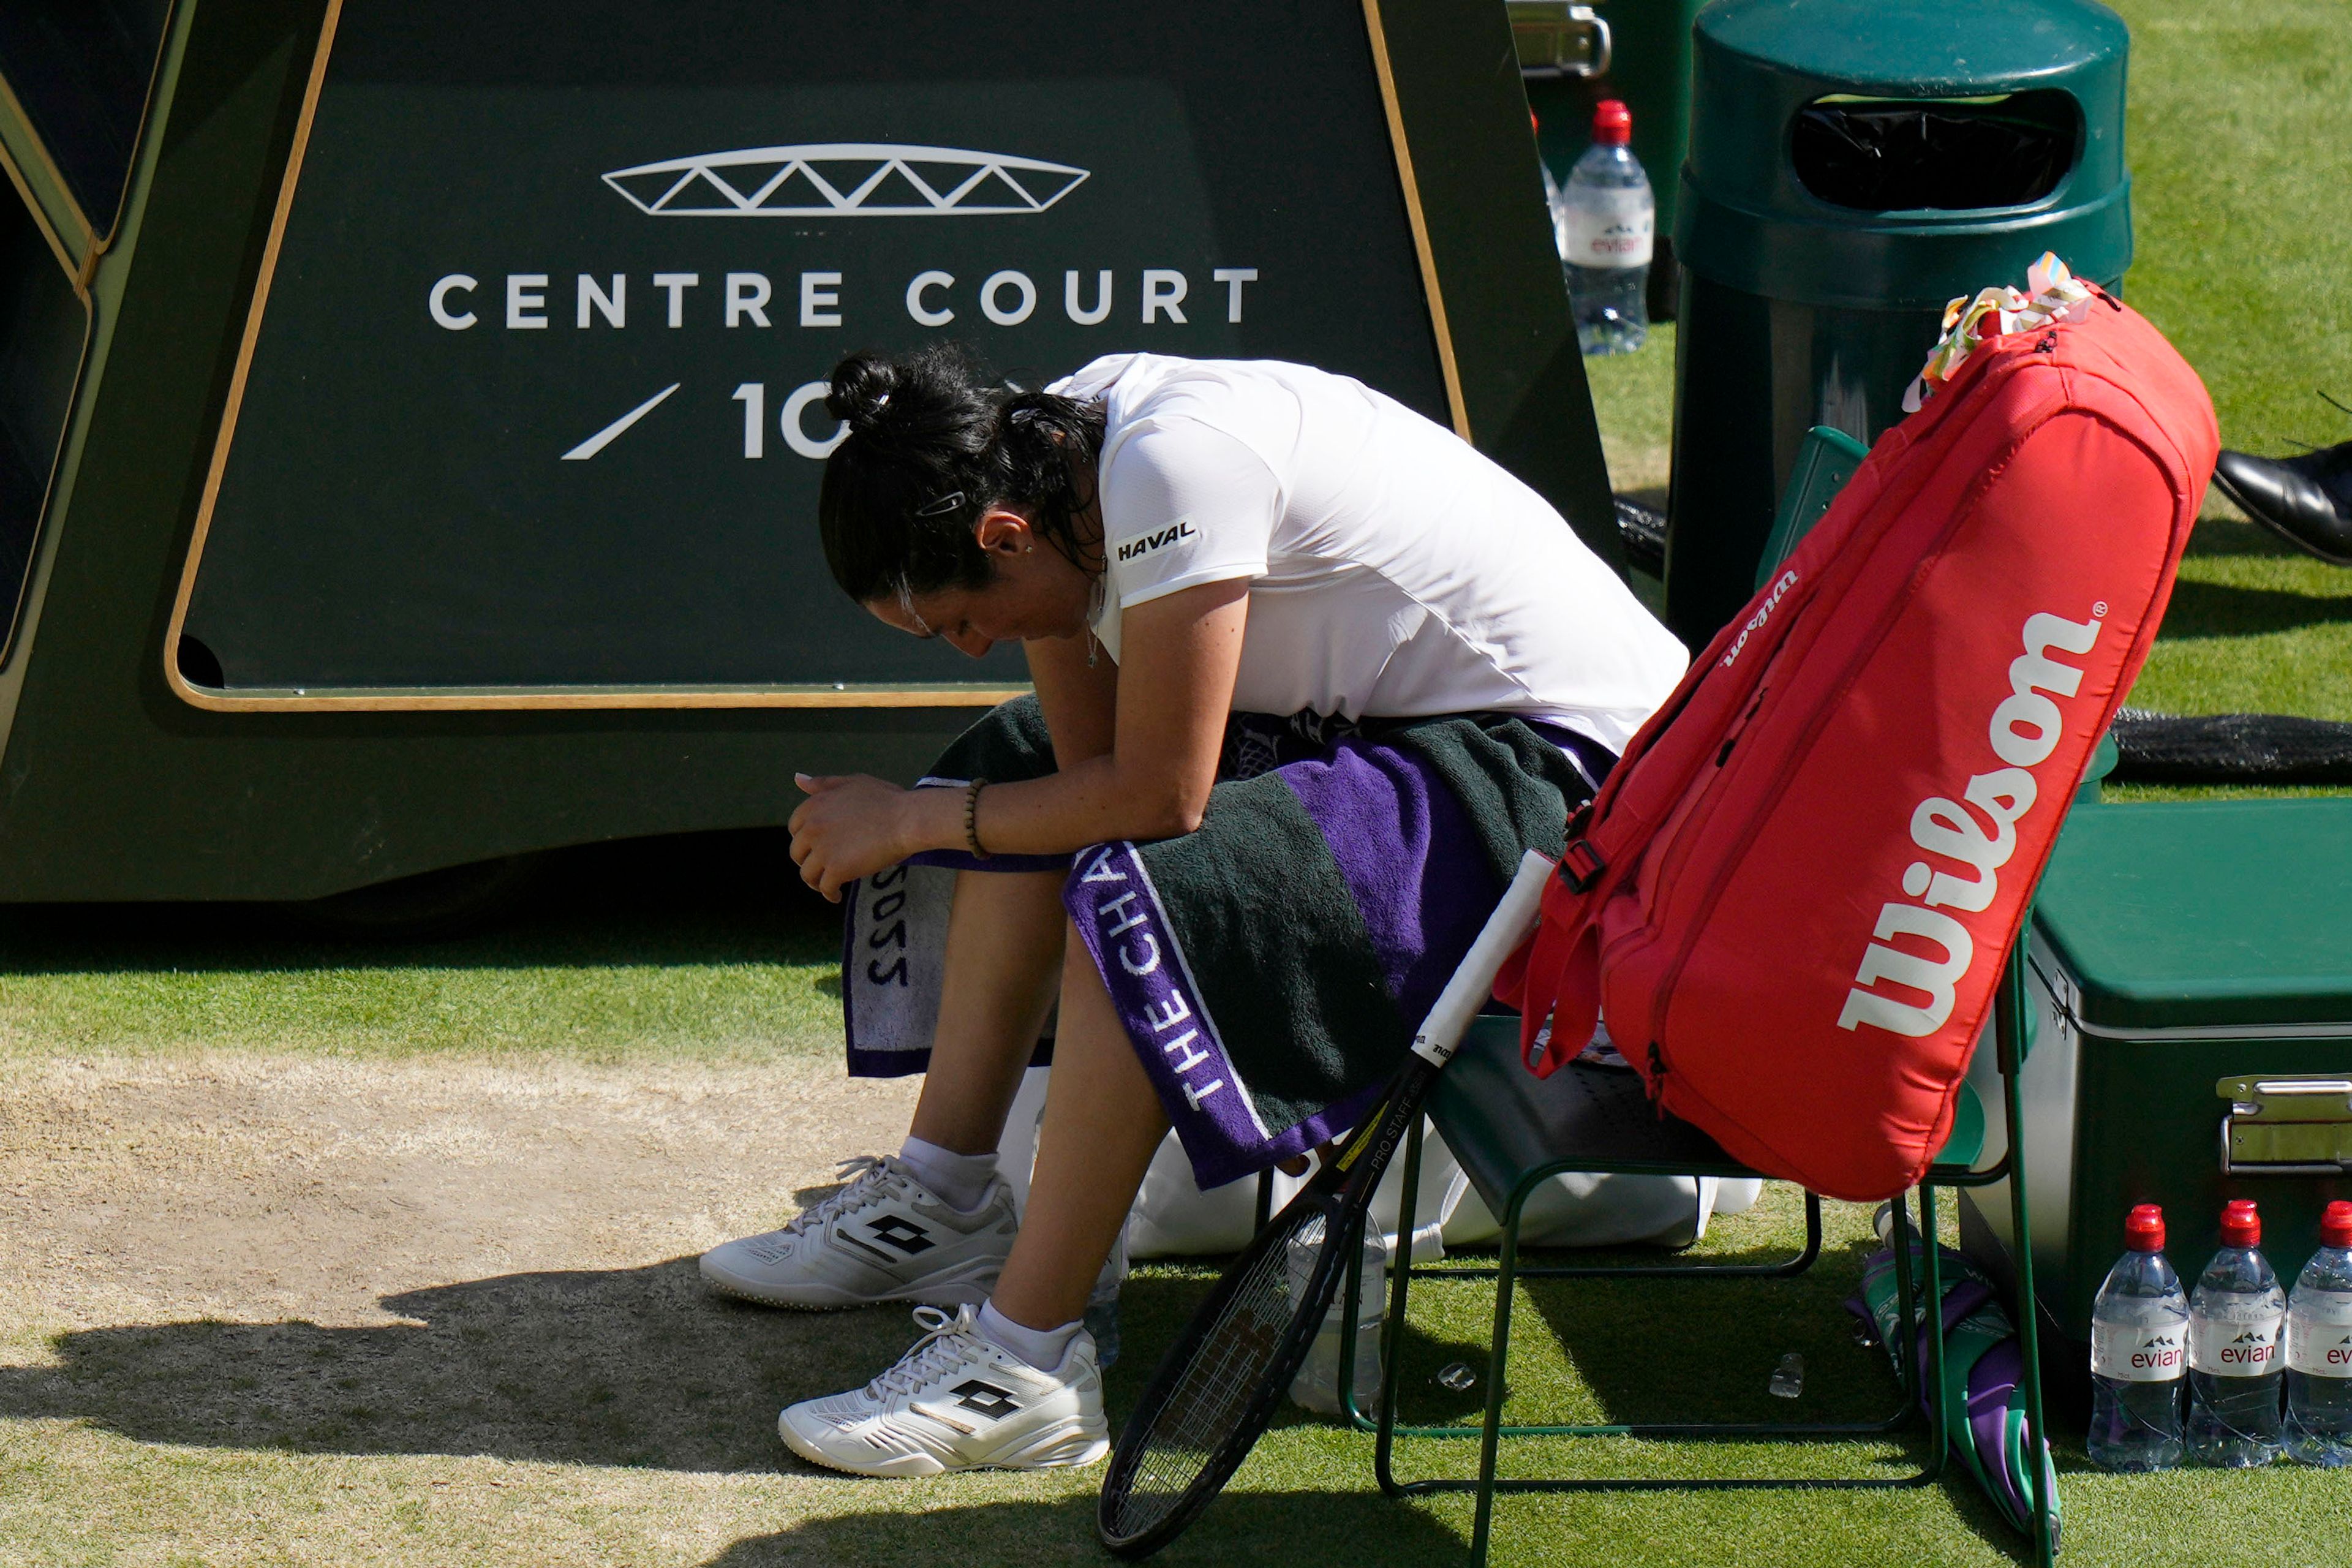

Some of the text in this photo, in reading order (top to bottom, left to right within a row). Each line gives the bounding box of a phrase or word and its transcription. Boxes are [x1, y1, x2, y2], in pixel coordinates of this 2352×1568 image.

[429, 268, 1259, 330] CENTRE COURT
[731, 381, 853, 459] 10
[1118, 521, 1196, 561] HAVAL
[1723, 570, 1799, 667] Wilson
[1837, 612, 2102, 1038] Wilson
[1144, 989, 1224, 1112] THE
[1371, 1096, 1413, 1170] PRO STAFF
[2131, 1349, 2183, 1368] evian
[2220, 1345, 2274, 1363] evian
